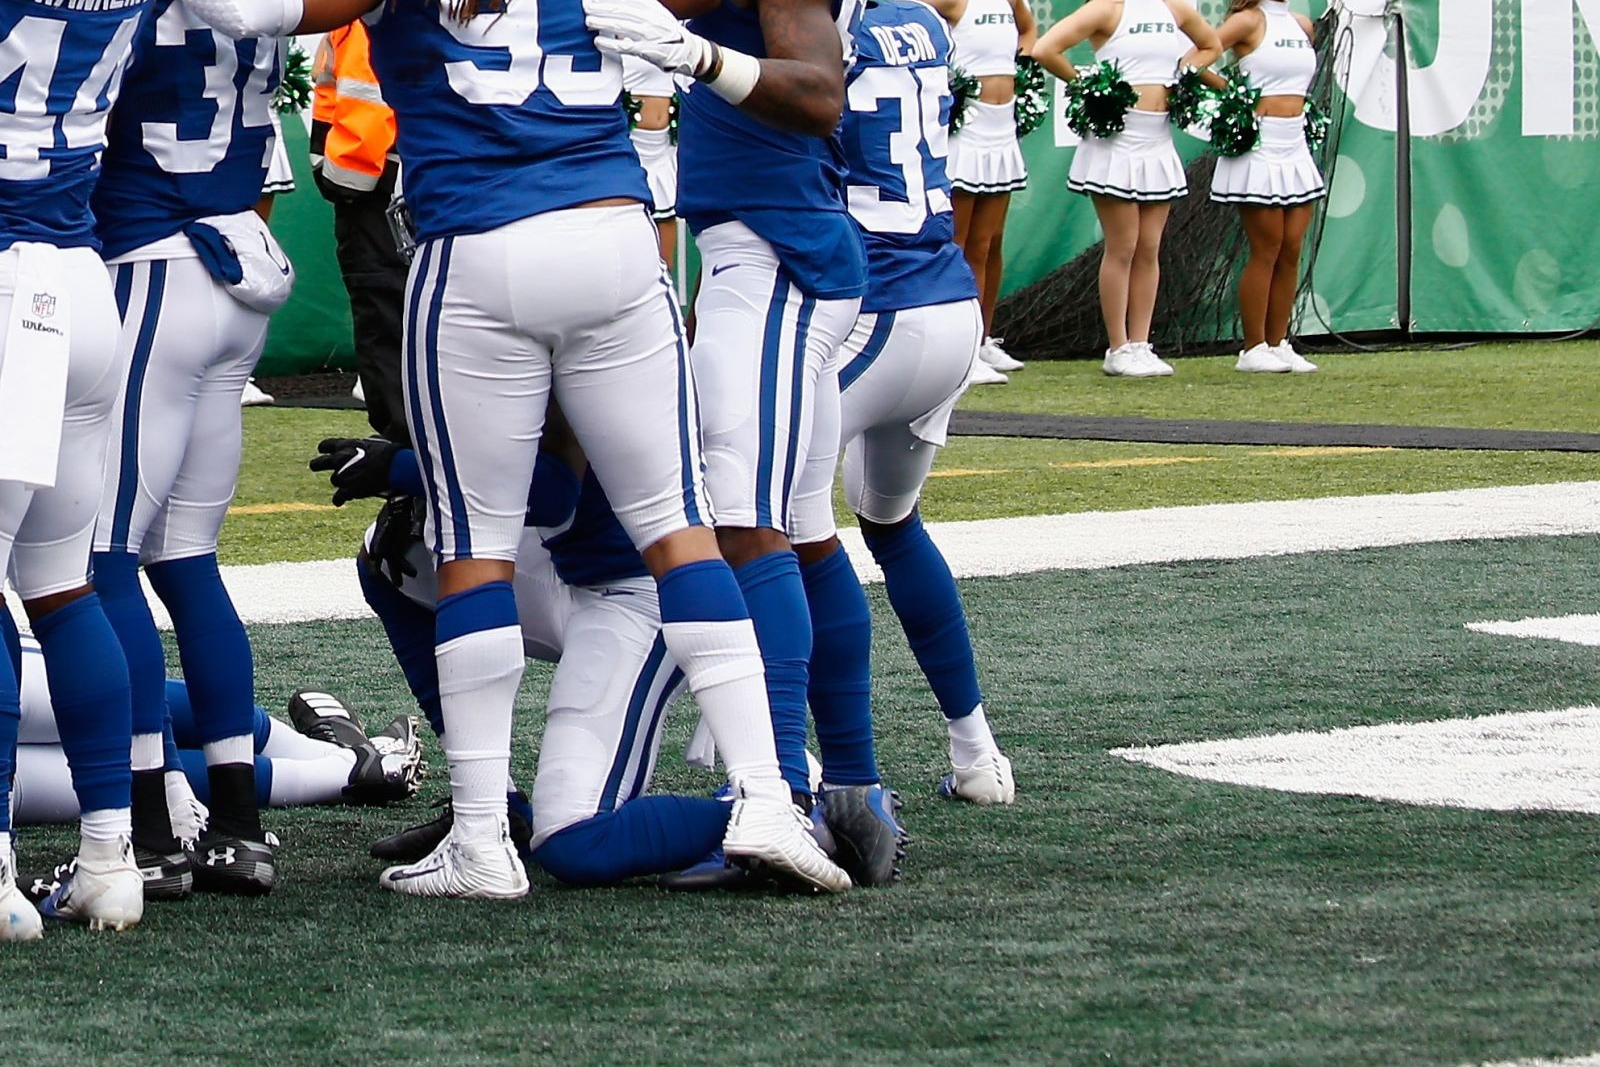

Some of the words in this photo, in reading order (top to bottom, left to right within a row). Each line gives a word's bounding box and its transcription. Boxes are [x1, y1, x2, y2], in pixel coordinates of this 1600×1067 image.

[974, 13, 1016, 27] JETS
[1128, 22, 1175, 35] JETS
[1274, 39, 1312, 50] JETS
[21, 318, 64, 337] Wilson
